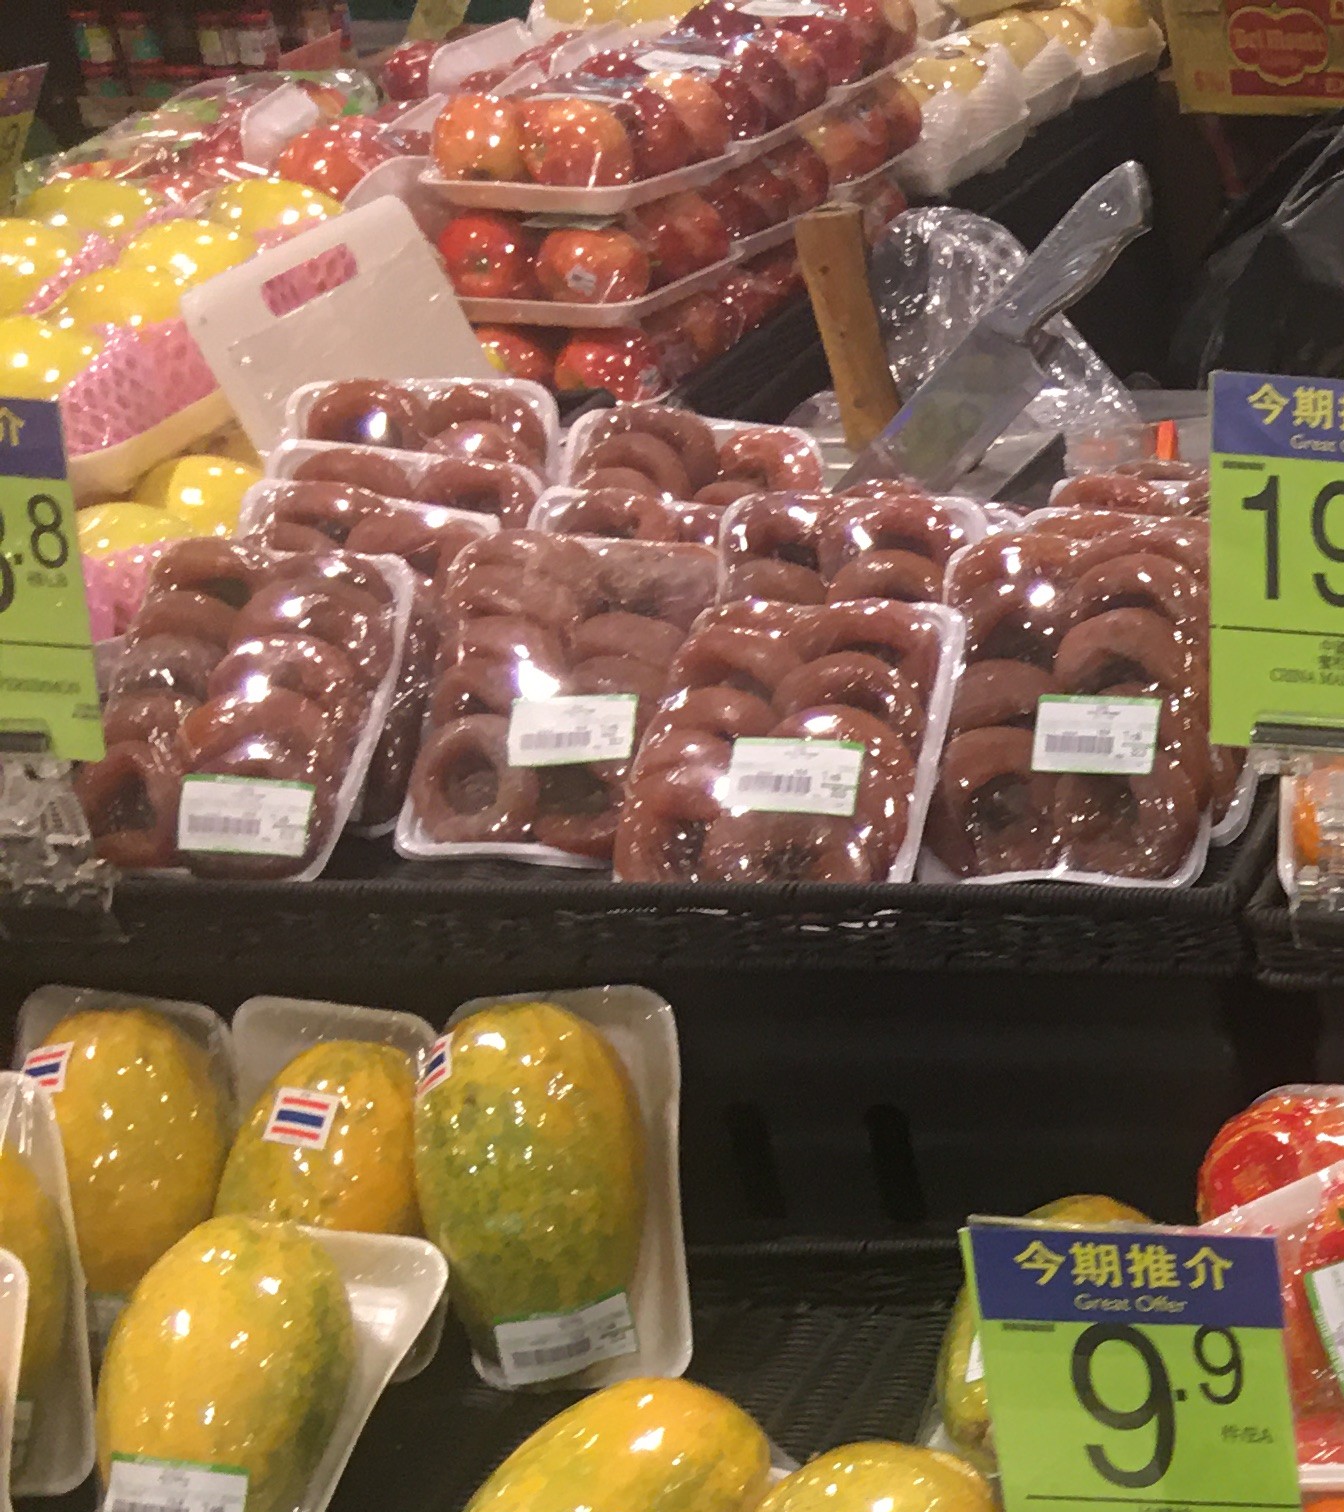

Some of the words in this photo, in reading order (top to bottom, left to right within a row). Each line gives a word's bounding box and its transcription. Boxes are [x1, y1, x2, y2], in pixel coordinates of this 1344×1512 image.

[1290, 434, 1336, 454] Great
[0, 494, 68, 614] .8
[1013, 1240, 1234, 1291] 今期推介
[1073, 1293, 1131, 1312] Great
[1134, 1295, 1188, 1314] Offer
[1069, 1321, 1243, 1489] 9.9
